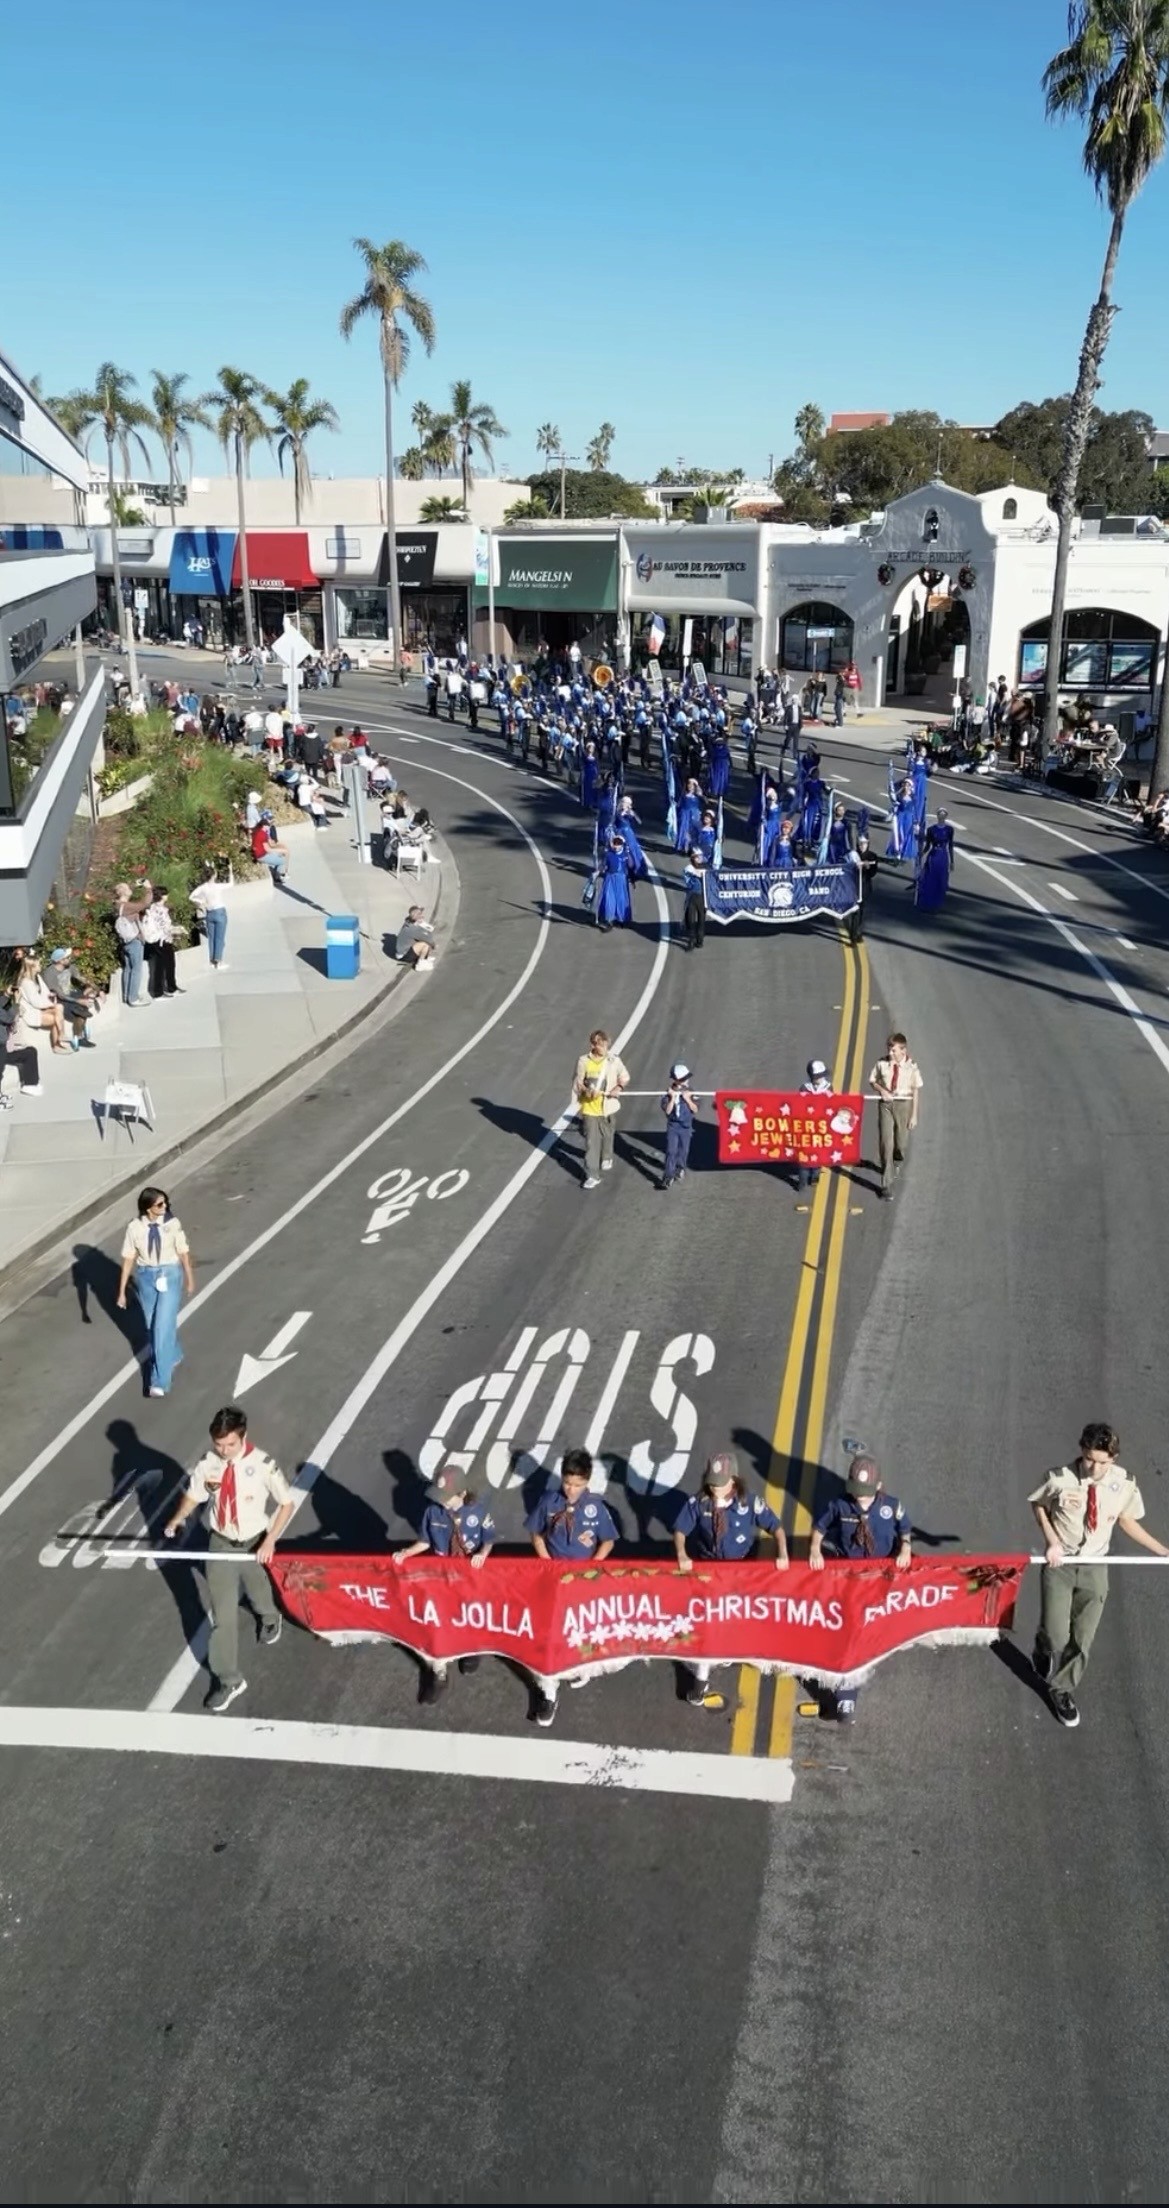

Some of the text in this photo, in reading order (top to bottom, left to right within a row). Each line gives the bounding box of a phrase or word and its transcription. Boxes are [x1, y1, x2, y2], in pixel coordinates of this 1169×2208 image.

[691, 562, 702, 571] DE
[703, 562, 747, 572] PROVENCE
[718, 867, 845, 881] UNIVERSITY CITY HIGH SCHOOL
[718, 887, 830, 899] CENTURION BAND
[754, 907, 770, 917] SAN
[799, 906, 811, 914] CA
[753, 1117, 828, 1133] BOWERS
[339, 1584, 391, 1610] THE
[408, 1595, 441, 1628] LA
[451, 1601, 535, 1640] JOLLA
[562, 1594, 672, 1637] ANNUAL
[687, 1594, 844, 1632] CHRISTMAS
